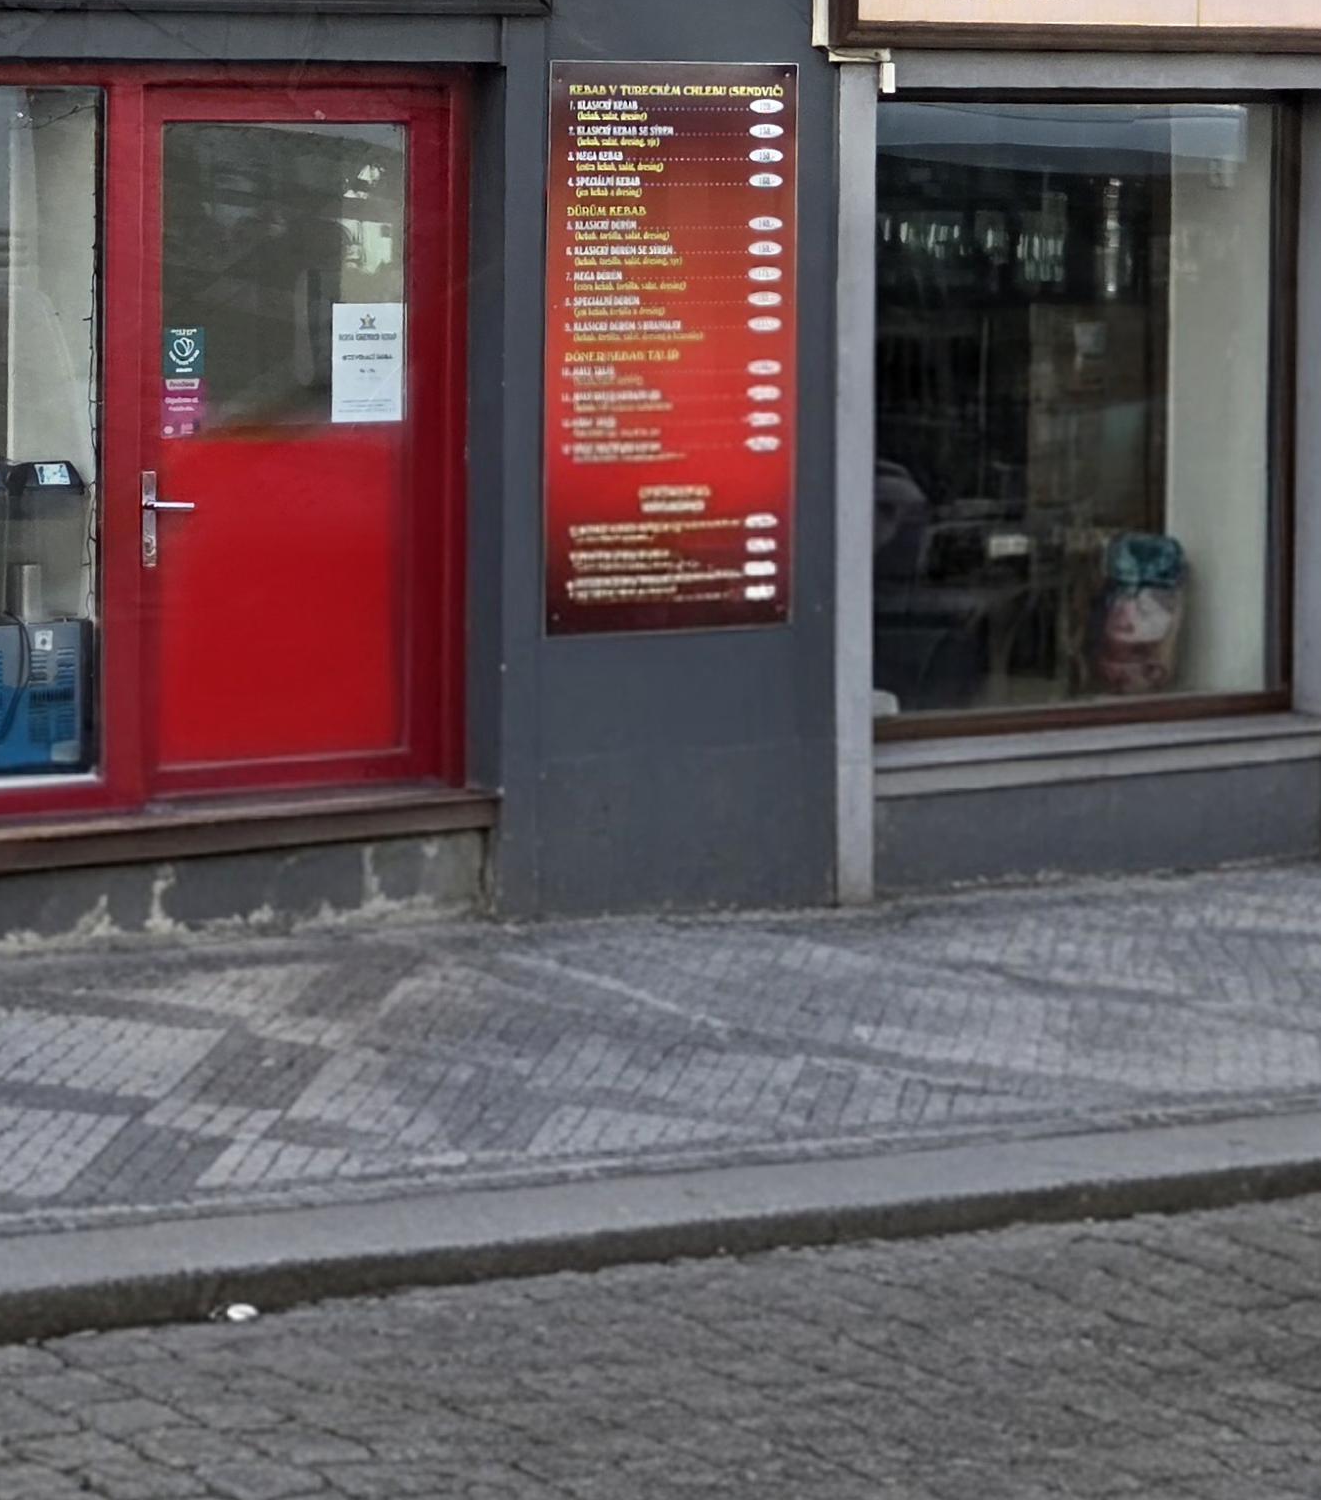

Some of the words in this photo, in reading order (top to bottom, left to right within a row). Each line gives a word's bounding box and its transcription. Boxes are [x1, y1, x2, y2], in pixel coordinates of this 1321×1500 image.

[570, 85, 606, 96] KEBAB
[609, 85, 617, 96] V
[609, 206, 647, 216] KEBAB
